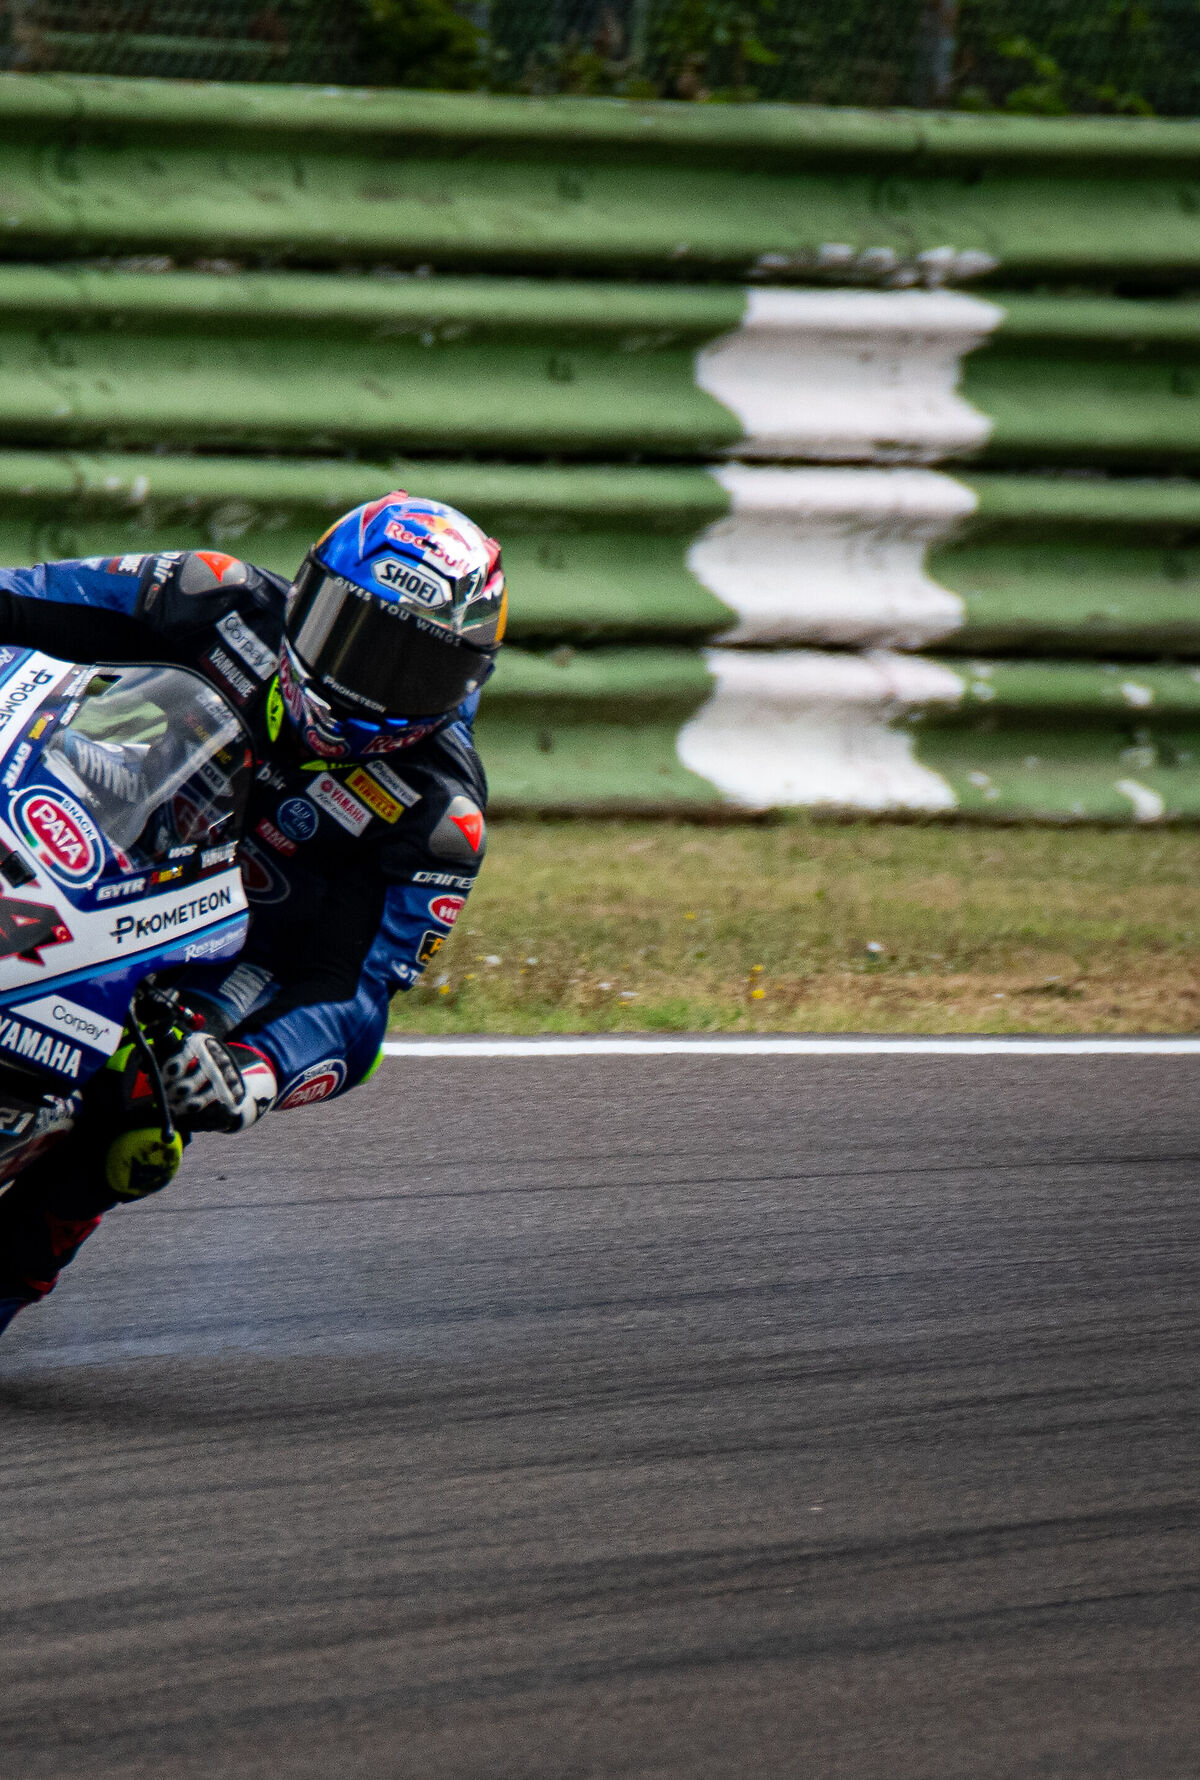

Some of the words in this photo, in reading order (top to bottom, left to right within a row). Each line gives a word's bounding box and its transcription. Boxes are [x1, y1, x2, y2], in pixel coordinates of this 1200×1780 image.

[335, 576, 372, 601] GIVES
[380, 601, 409, 621] YOU
[381, 563, 437, 603] SHOEI
[62, 798, 98, 841] SNACK
[330, 788, 366, 824] YAMAHA
[31, 802, 84, 867] PATA
[97, 877, 146, 901] GYTR
[412, 871, 477, 889] DAINE
[109, 886, 232, 944] PROMETEON
[52, 1005, 105, 1040] Corpay
